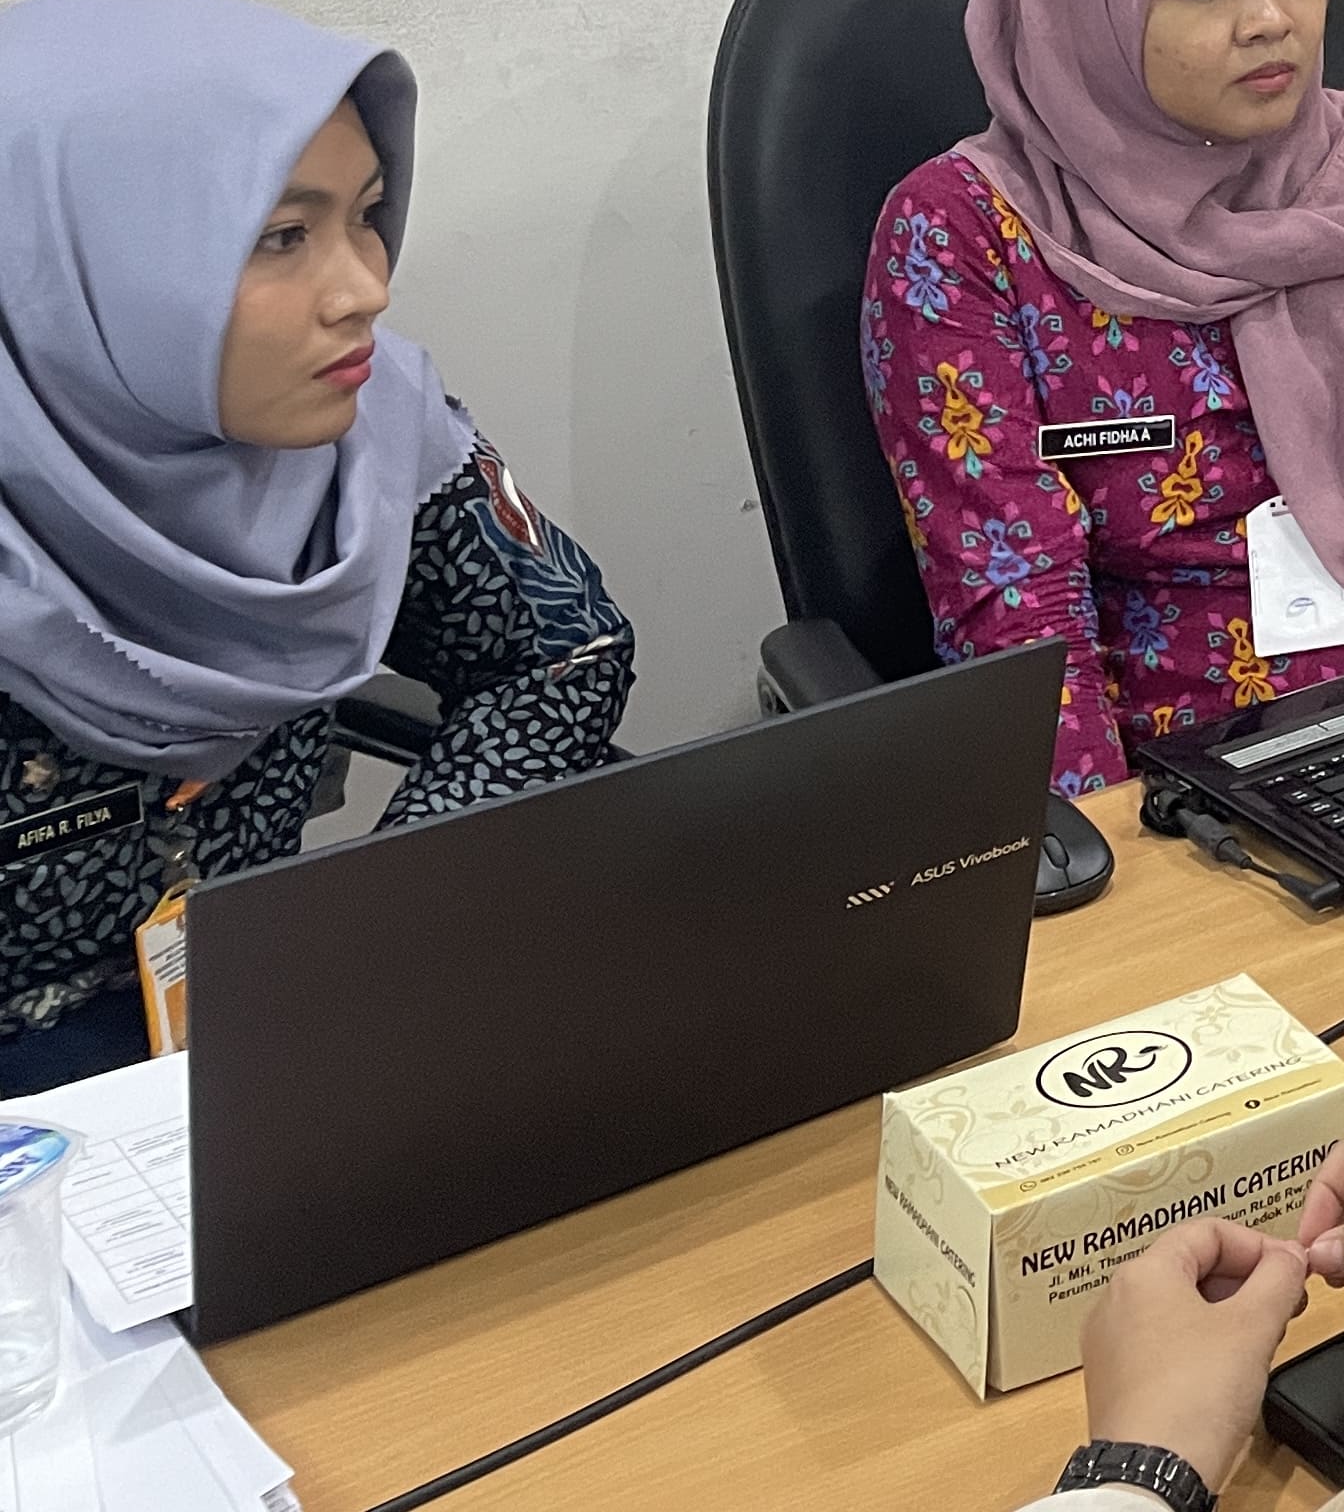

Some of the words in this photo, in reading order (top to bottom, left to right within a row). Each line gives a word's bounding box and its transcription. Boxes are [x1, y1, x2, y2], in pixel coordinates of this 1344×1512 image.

[1063, 433, 1097, 449] ACHI
[1099, 429, 1139, 446] FIDHA
[1140, 427, 1152, 441] A
[17, 825, 55, 849] AFIFA
[58, 818, 73, 838] R.
[77, 807, 112, 830] FILYA
[910, 860, 956, 888] ASUS
[958, 836, 1031, 870] Vivobook
[995, 1143, 1046, 1169] NEW
[1051, 1092, 1193, 1147] RAMADHANI
[1195, 1055, 1304, 1097] CATERING
[1021, 1239, 1077, 1277] NEW
[1082, 1184, 1227, 1254] RAMADHANI
[1048, 1274, 1111, 1305] Perumah
[1245, 1207, 1283, 1229] Ledok
[1068, 1263, 1096, 1282] MH.
